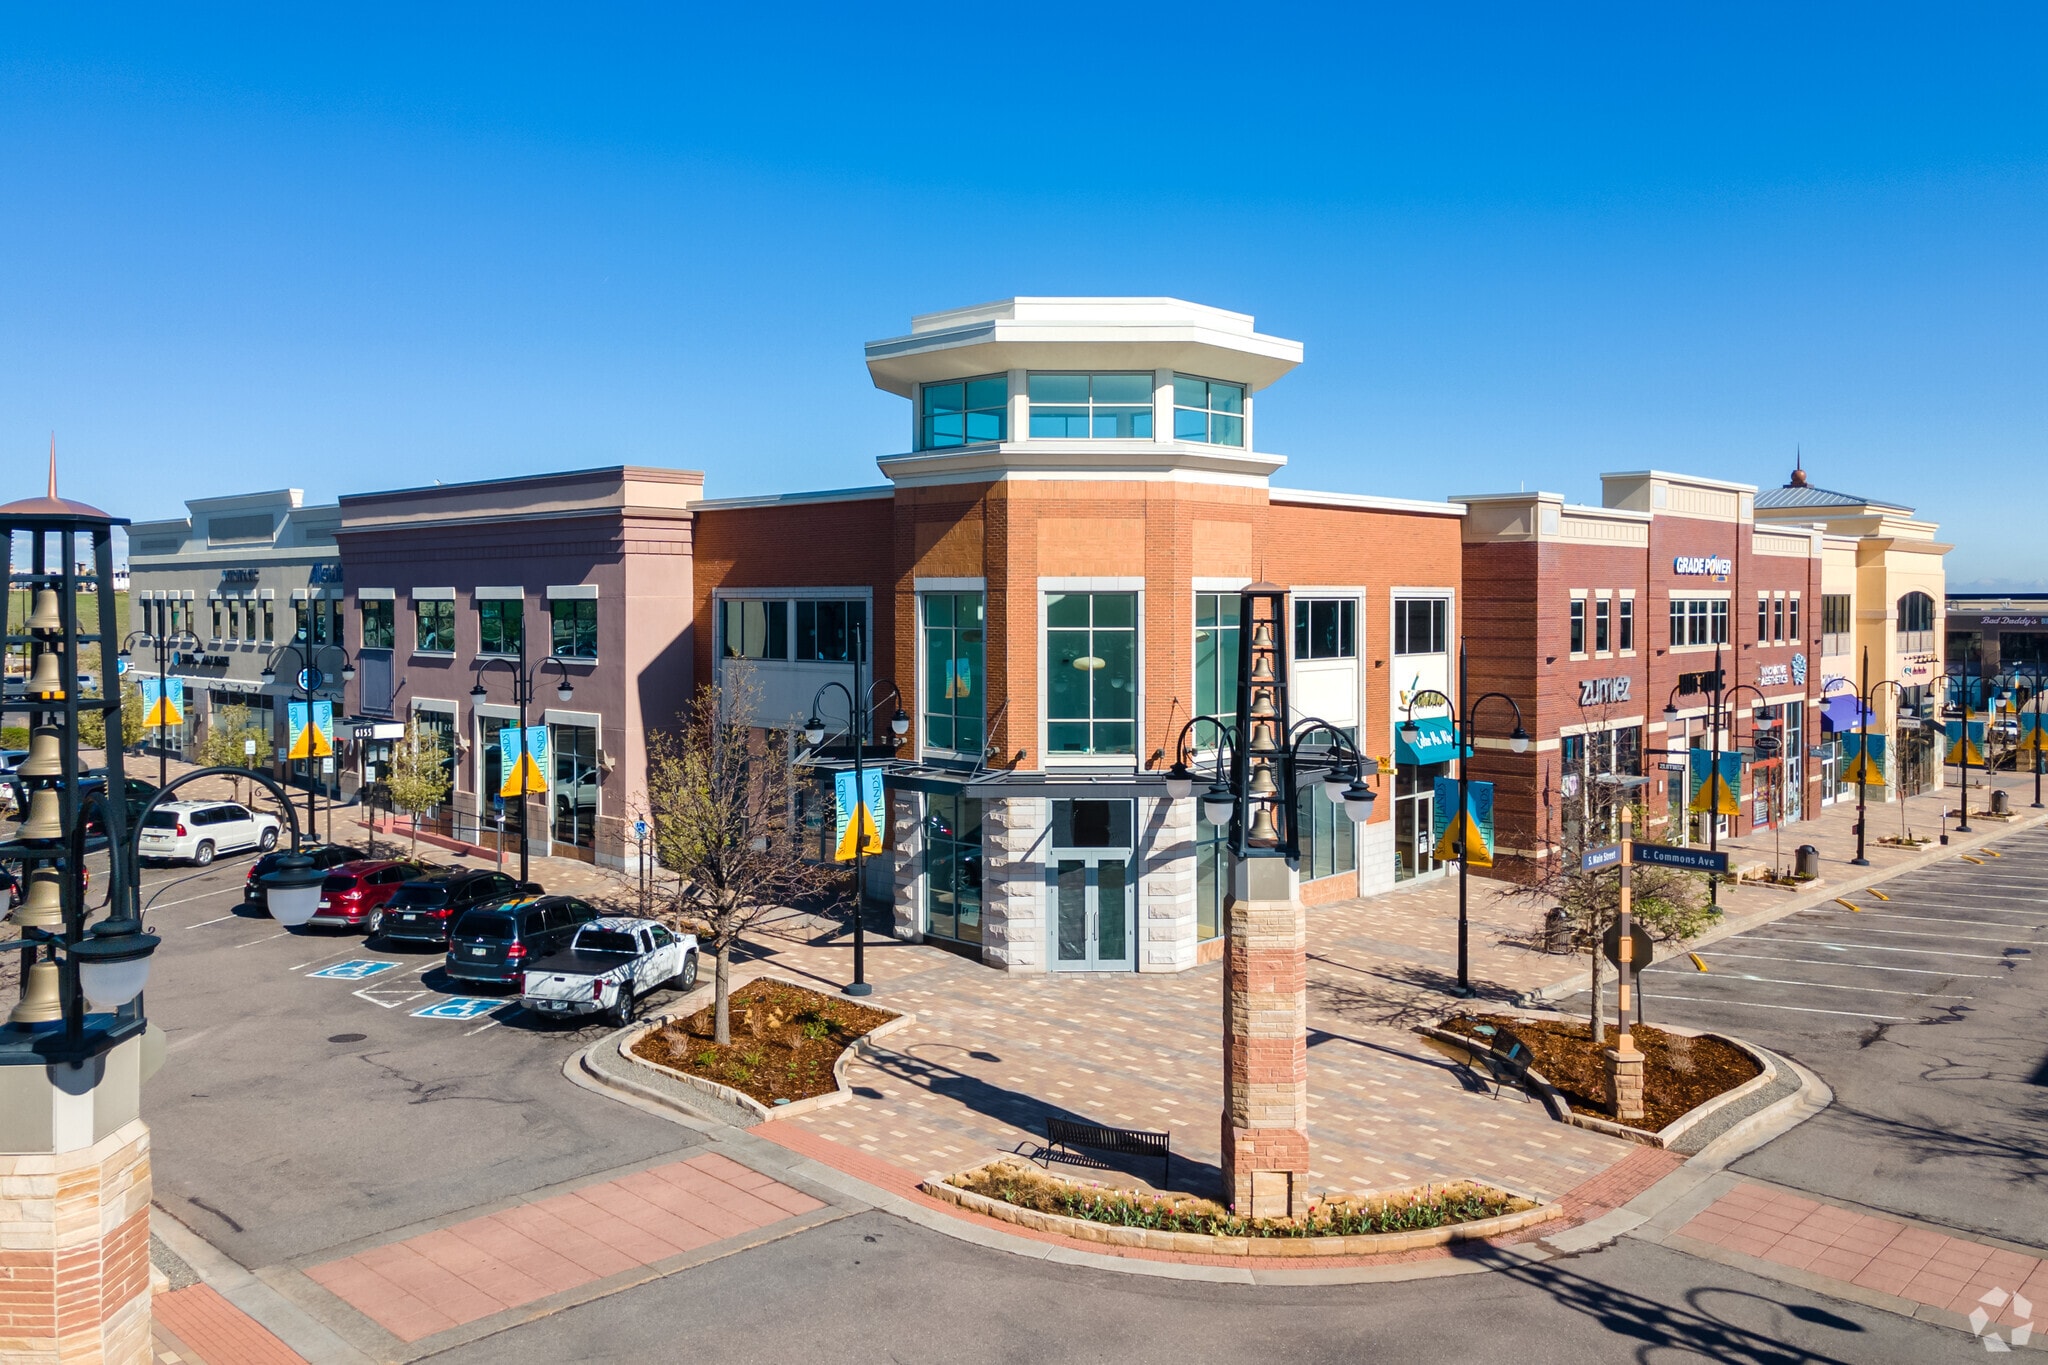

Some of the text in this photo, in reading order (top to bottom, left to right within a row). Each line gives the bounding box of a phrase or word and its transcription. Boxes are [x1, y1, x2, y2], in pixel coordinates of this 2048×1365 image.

[1675, 556, 1731, 575] GRADE POWER
[1981, 616, 2000, 625] Bad
[2001, 616, 2037, 626] Daddy's
[354, 727, 373, 738] 6155
[537, 730, 548, 789] SOUTHLANDS
[502, 732, 513, 793] SOUTHLANDS
[836, 778, 848, 855] SOUTHLANDS
[872, 774, 884, 849] SOUTHLANDS
[1434, 782, 1449, 855] SOUTHLANDS
[1480, 787, 1493, 861] SOUTHLANDS
[1593, 853, 1603, 865] Main
[1603, 850, 1616, 863] Street
[1642, 849, 1715, 867] E. Commons Ave
